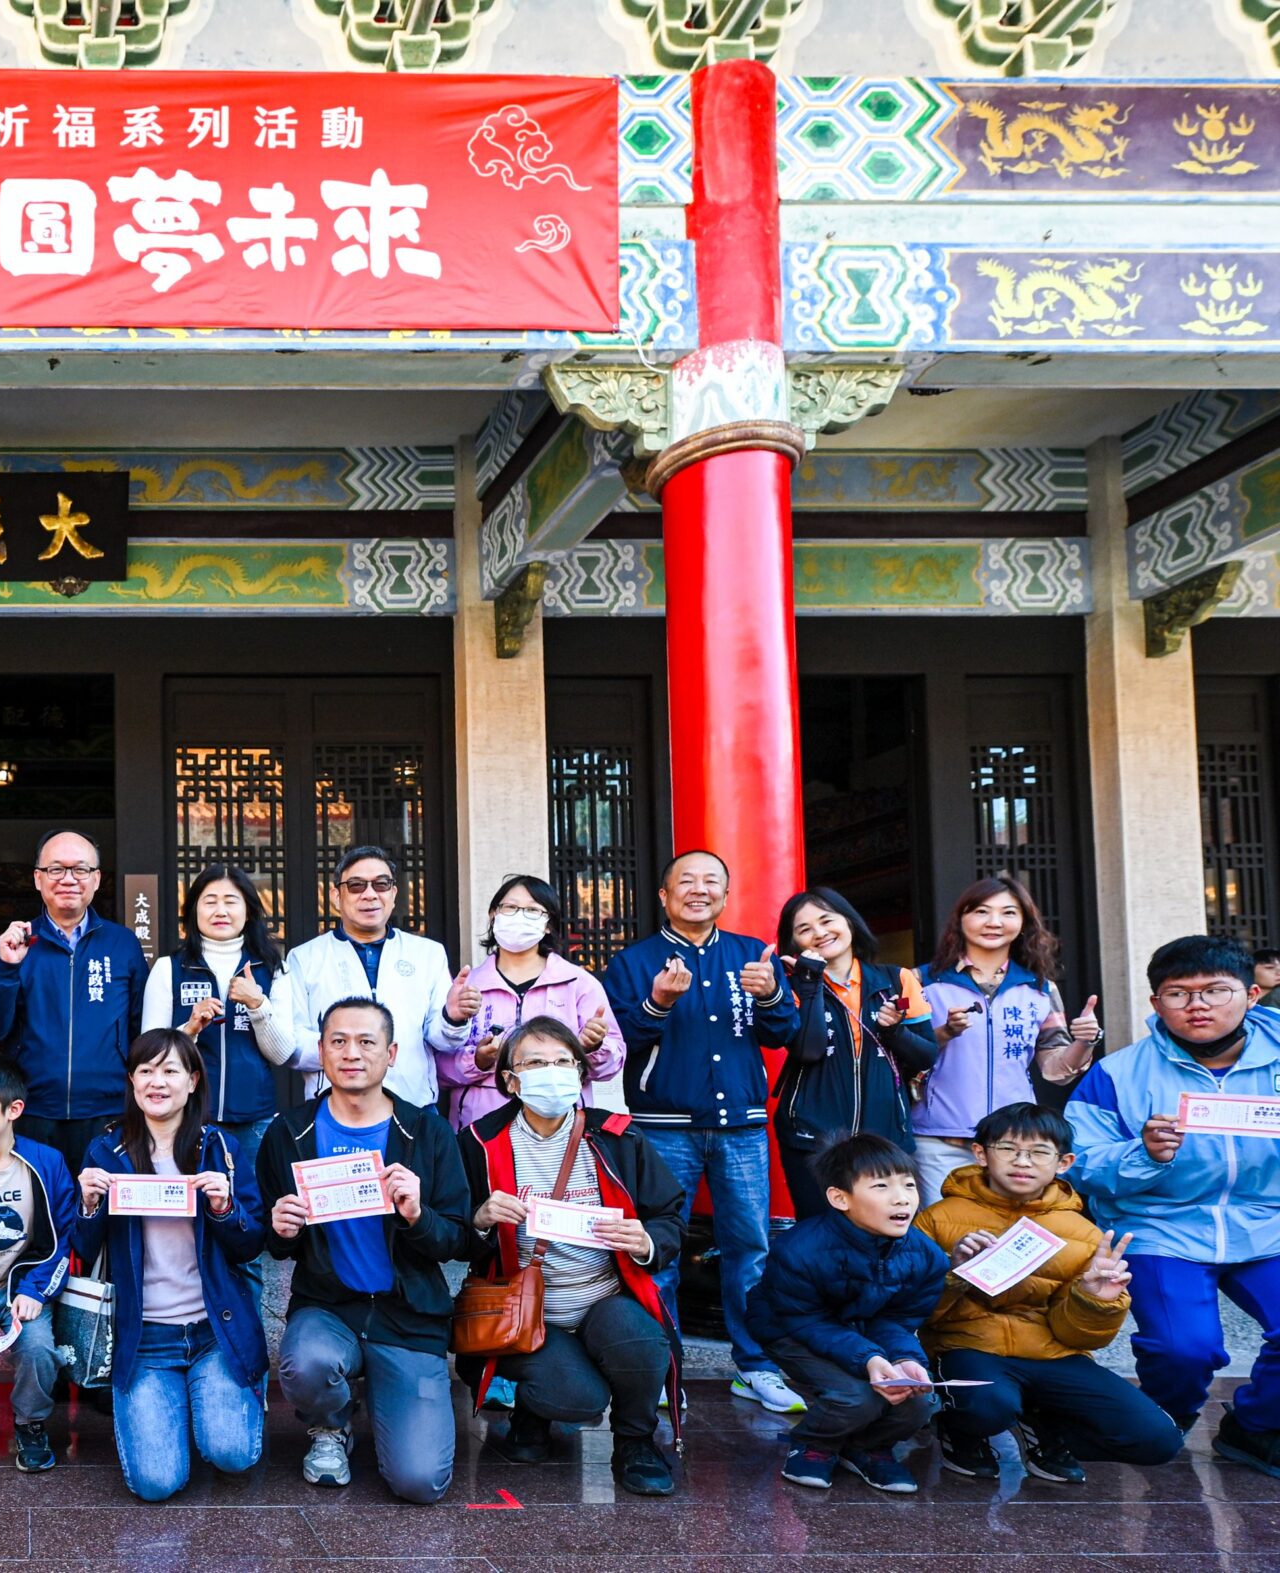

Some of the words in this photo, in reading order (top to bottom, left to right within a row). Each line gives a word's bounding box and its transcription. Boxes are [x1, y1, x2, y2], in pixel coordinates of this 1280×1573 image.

[134, 892, 151, 940] 大成殿
[88, 958, 104, 1002] 林政賢
